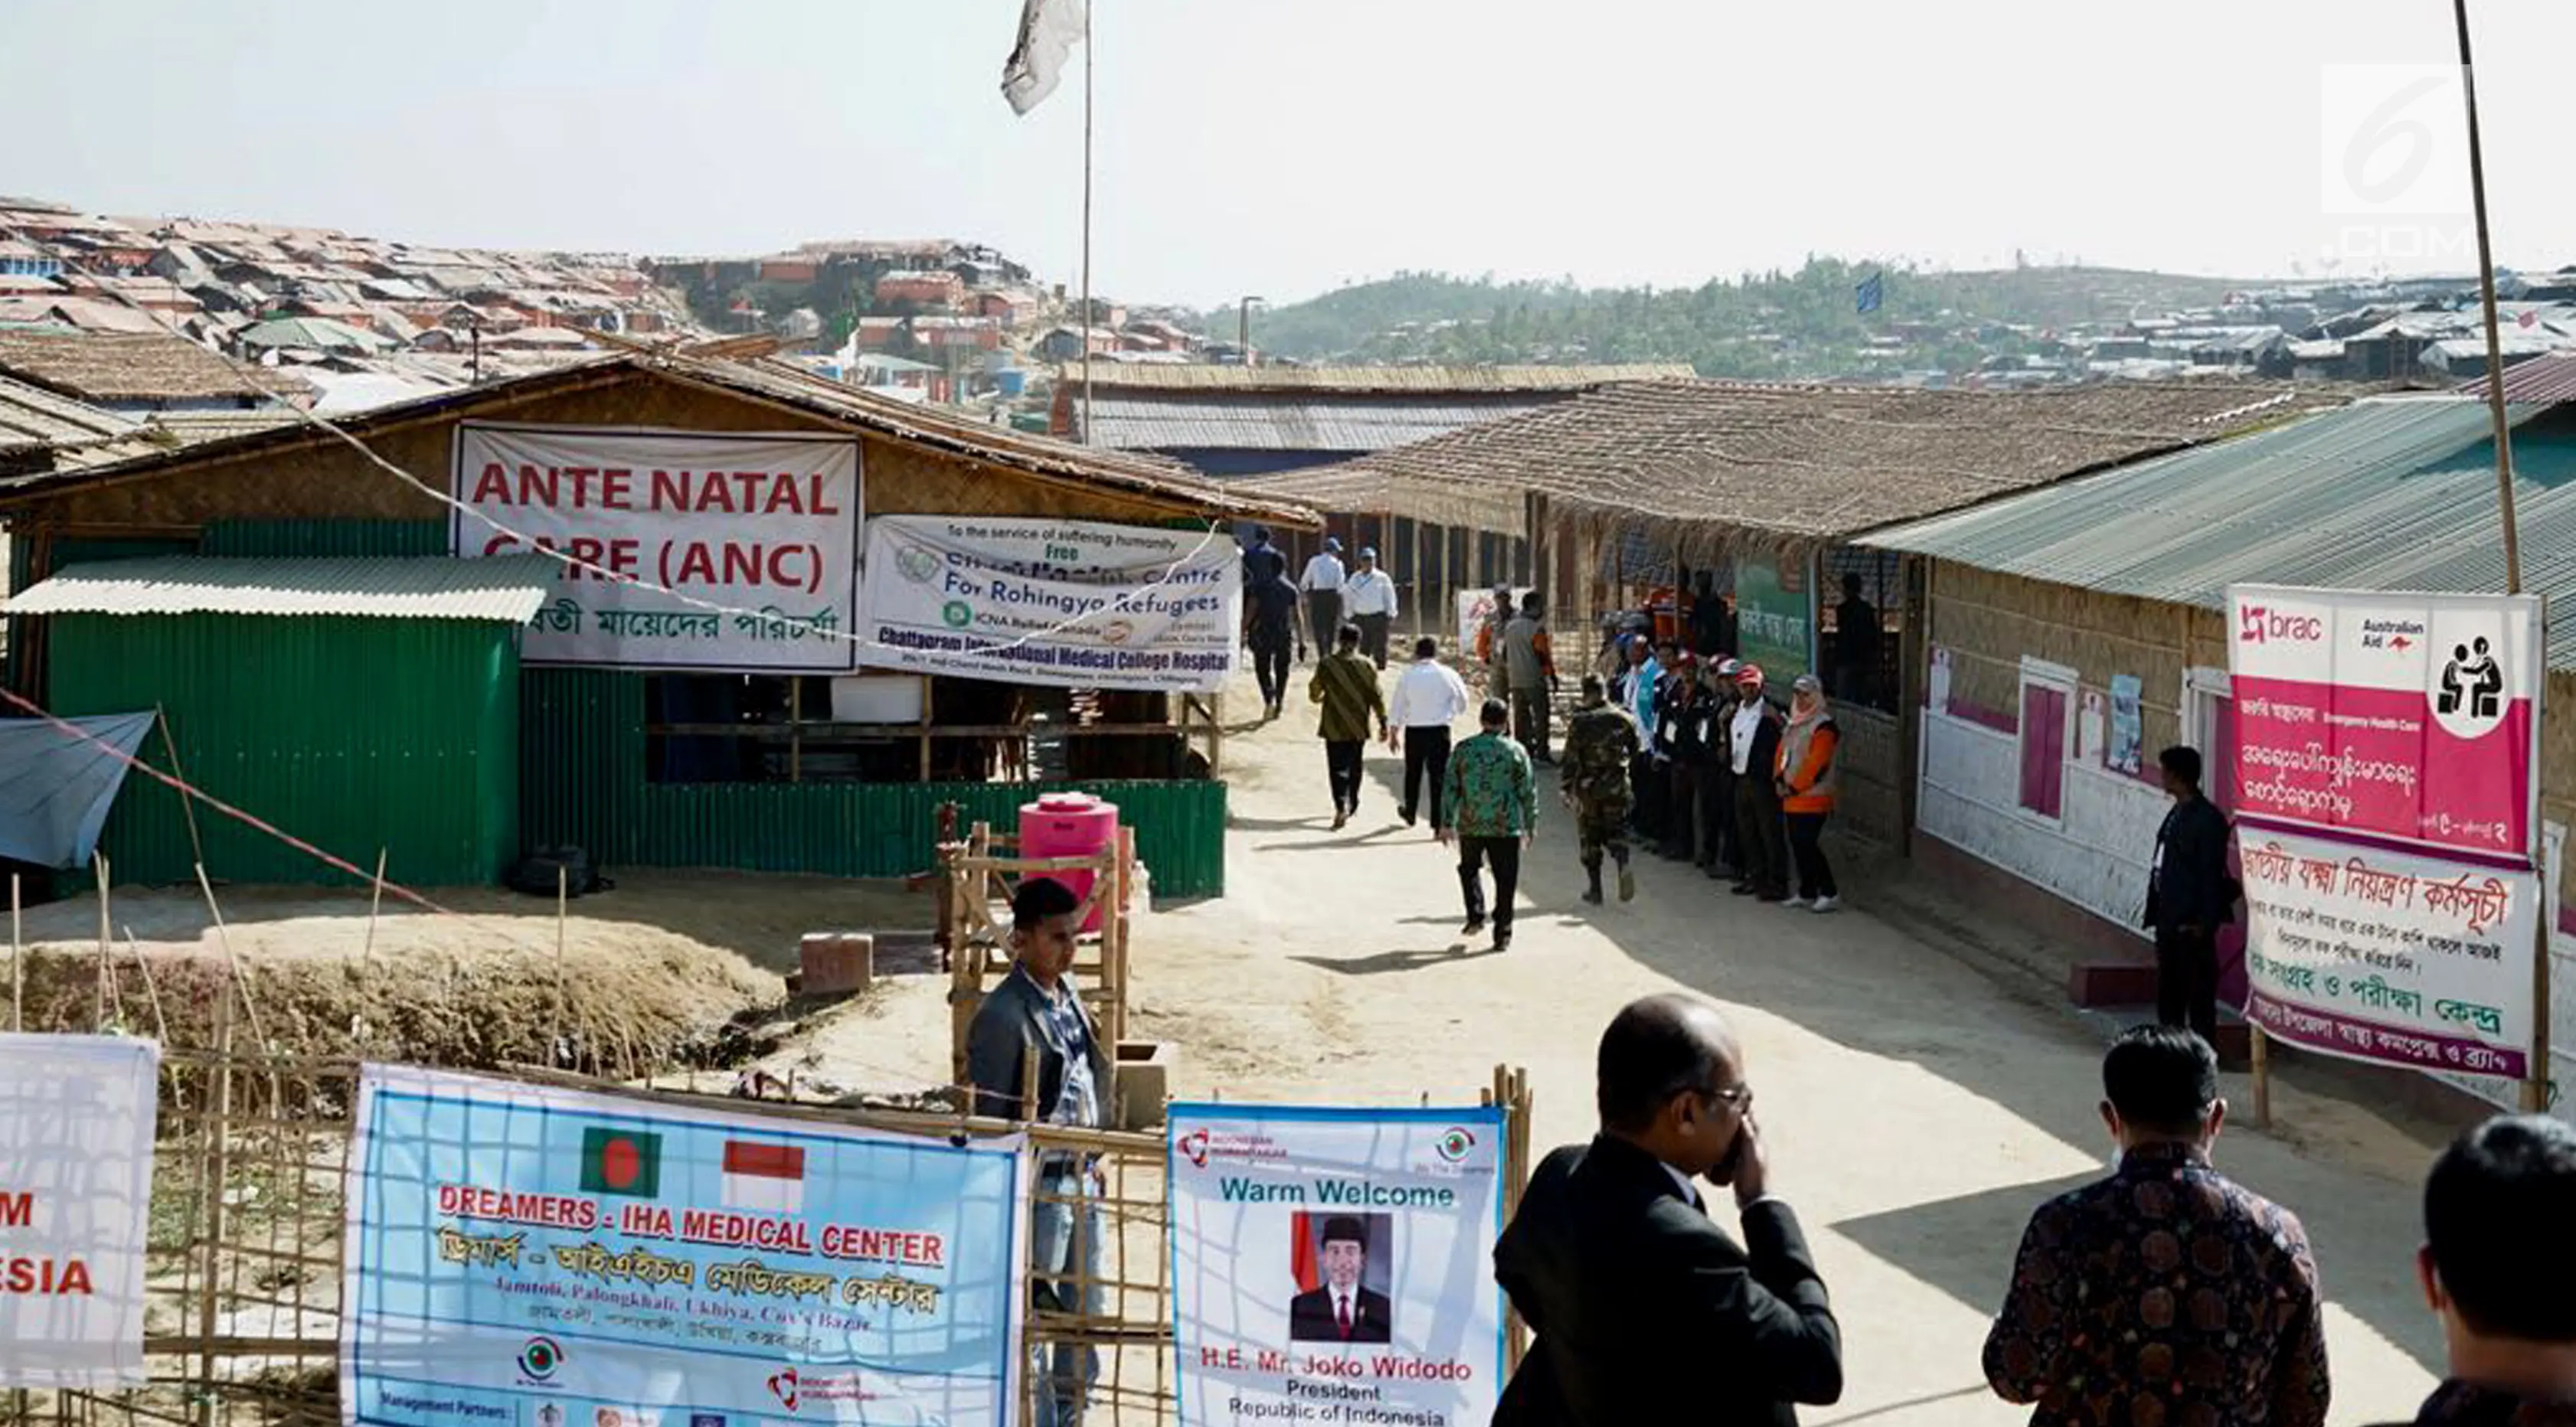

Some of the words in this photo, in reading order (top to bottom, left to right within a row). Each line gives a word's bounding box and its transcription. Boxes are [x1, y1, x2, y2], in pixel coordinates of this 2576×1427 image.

[472, 462, 633, 511] ANTE
[649, 470, 839, 517] NATAL
[947, 524, 963, 536] To
[966, 526, 988, 537] the
[991, 527, 1039, 538] service
[1041, 527, 1056, 540] of
[1058, 528, 1111, 547] suffering
[1116, 534, 1178, 553] humanity
[1044, 543, 1079, 560] Free
[658, 537, 823, 594] (ANC)
[944, 571, 983, 596] For
[1114, 592, 1220, 618] Refugees
[597, 610, 720, 638] মায়েদের
[734, 606, 840, 643] পরিচর্যা
[975, 612, 1008, 626] ICNA
[1011, 616, 1048, 630] Relief
[1050, 622, 1101, 636] Canada
[2268, 607, 2323, 642] brac
[2361, 618, 2424, 635] Australian
[964, 636, 1056, 665] International
[1058, 648, 1115, 670] Medical
[1116, 651, 1170, 671] College
[1172, 651, 1231, 672] Hospital
[2362, 634, 2383, 649] Aid
[2324, 975, 2340, 997] ও
[2349, 973, 2422, 1020] পরীক্ষা
[2434, 998, 2502, 1037] কেন্দ্র
[1220, 1177, 1306, 1203] Warm
[1315, 1178, 1455, 1207] Welcome
[438, 1185, 597, 1229] DREAMERS
[622, 1205, 674, 1235] IHA
[682, 1210, 812, 1251] MEDICAL
[821, 1226, 945, 1265] CENTER
[0, 1257, 93, 1295] SIA
[705, 1258, 840, 1302] মেডিকেল
[842, 1272, 944, 1315] সেন্টার
[1200, 1347, 1249, 1371] H.E.
[1257, 1351, 1293, 1373] Mr.
[1302, 1354, 1364, 1378] Joko
[1370, 1356, 1473, 1381] Widodo
[379, 1390, 456, 1415] Management
[1286, 1380, 1382, 1402] President
[1228, 1398, 1315, 1422] Republic
[1320, 1403, 1340, 1421] of
[1345, 1407, 1445, 1427] Indonesia
